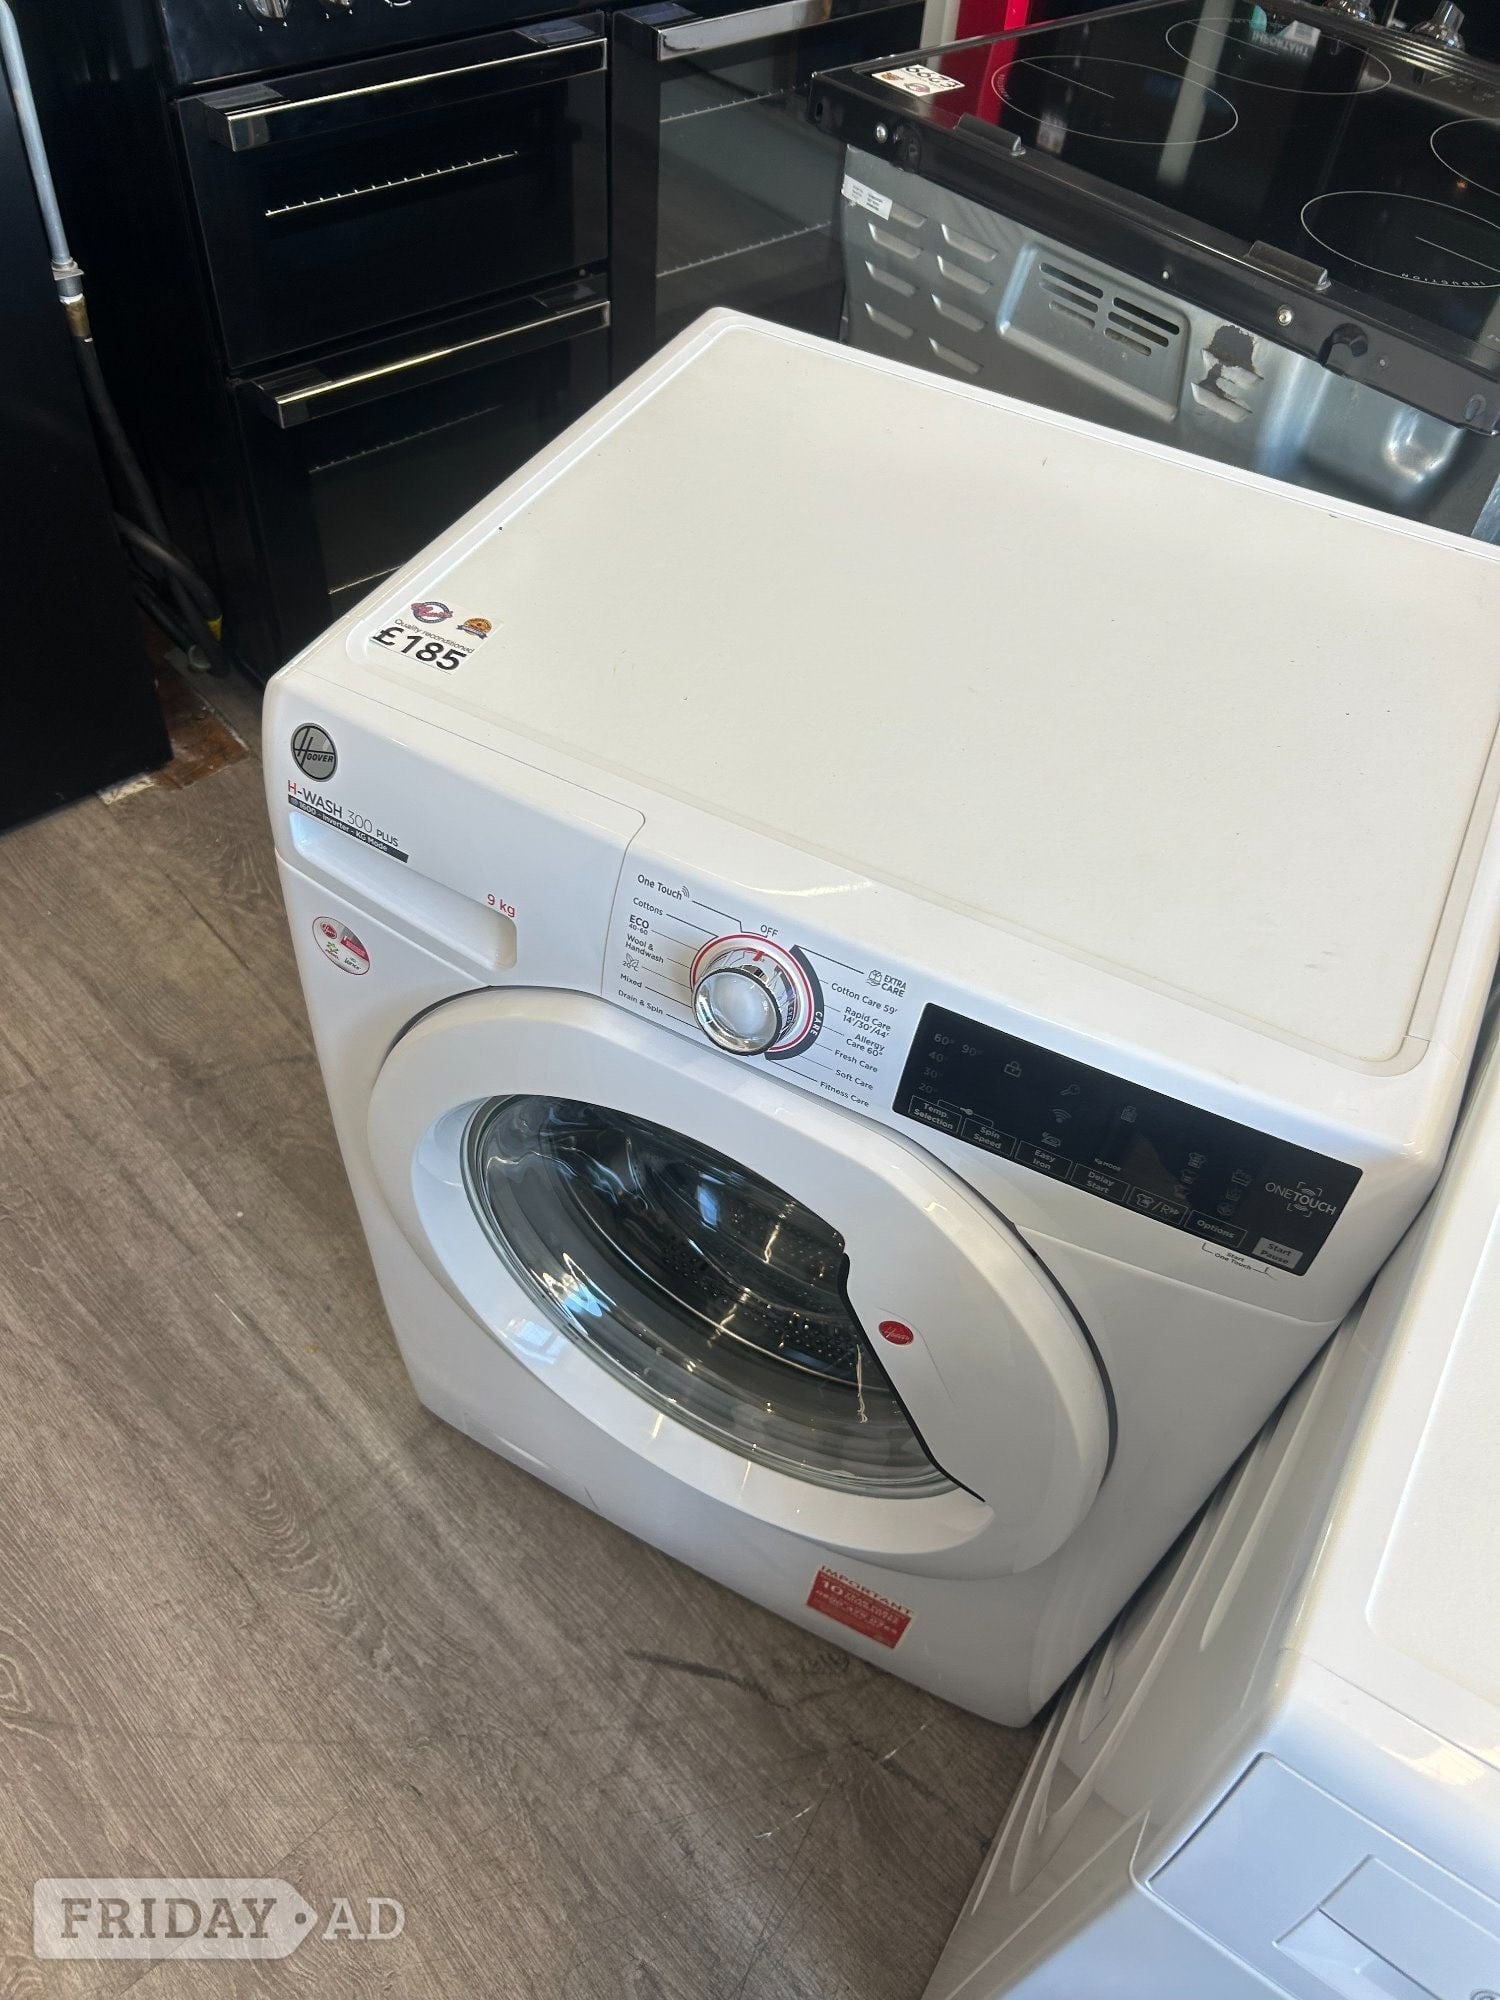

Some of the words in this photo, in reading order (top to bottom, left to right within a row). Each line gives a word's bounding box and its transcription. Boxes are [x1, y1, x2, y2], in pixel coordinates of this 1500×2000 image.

[394, 618, 422, 634] Quality
[423, 630, 476, 654] reconditioned
[372, 626, 468, 671] £185
[287, 779, 343, 819] H-WASH
[347, 810, 373, 834] 300
[377, 829, 399, 847] PLUS
[637, 874, 655, 889] One
[657, 882, 682, 901] Touch
[486, 893, 496, 906] 9
[499, 899, 516, 918] kg
[633, 897, 663, 916] Cottons
[629, 914, 650, 929] ECO
[760, 924, 779, 937] OFF
[626, 933, 647, 948] Wool
[648, 943, 655, 951] &
[625, 941, 664, 964] Handwash
[620, 973, 643, 988] Mixed
[883, 974, 907, 990] EXTRA
[831, 982, 860, 1001] Cotton
[862, 995, 881, 1010] Care
[881, 984, 906, 998] CARE
[618, 989, 638, 1003] Drain
[646, 1001, 663, 1015] Spin
[844, 1006, 870, 1023] Rapid
[871, 1018, 891, 1031] Care
[846, 1038, 865, 1052] Care
[854, 1033, 885, 1051] Allergy
[834, 1050, 857, 1065] Fresh
[859, 1060, 878, 1073] Care
[835, 1069, 853, 1082] Soft
[854, 1078, 874, 1091] Care
[819, 1081, 848, 1099] Fitness
[850, 1095, 869, 1108] Care
[913, 1107, 954, 1131] Selection
[923, 1102, 950, 1119] Temp.
[973, 1132, 1002, 1150] Speed
[980, 1125, 1001, 1140] Spin
[1032, 1157, 1051, 1171] Iron
[1034, 1148, 1056, 1164] Easy
[1086, 1179, 1110, 1195] Start
[1087, 1170, 1115, 1188] Delay
[1196, 1219, 1236, 1240] Options
[1226, 1252, 1245, 1263] Start
[1259, 1249, 1289, 1266] Pause
[1267, 1242, 1292, 1258] Start
[1214, 1252, 1230, 1262] One
[1231, 1258, 1252, 1271] Touch
[820, 1564, 914, 1614] IMPORTANT
